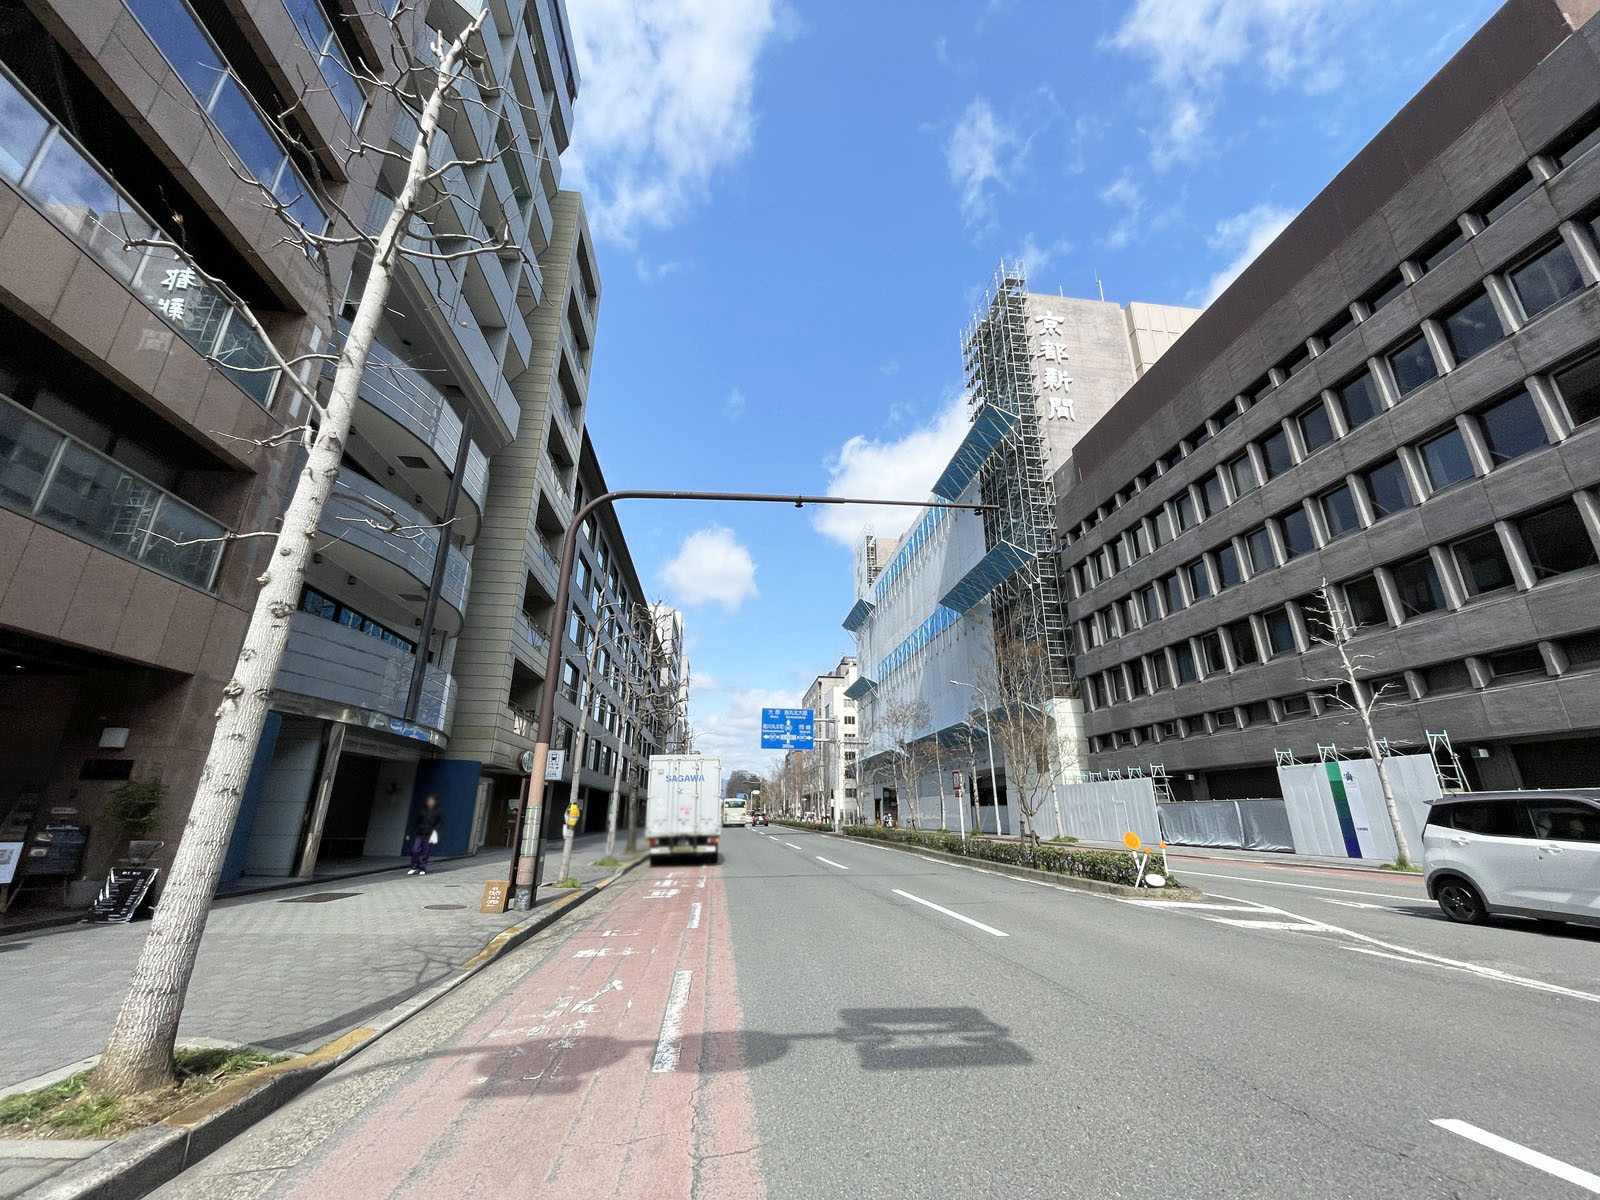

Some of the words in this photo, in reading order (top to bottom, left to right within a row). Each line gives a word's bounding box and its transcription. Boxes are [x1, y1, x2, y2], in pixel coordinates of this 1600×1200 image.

[1035, 311, 1076, 422] 京都新聞
[665, 775, 705, 783] SAGAWA
